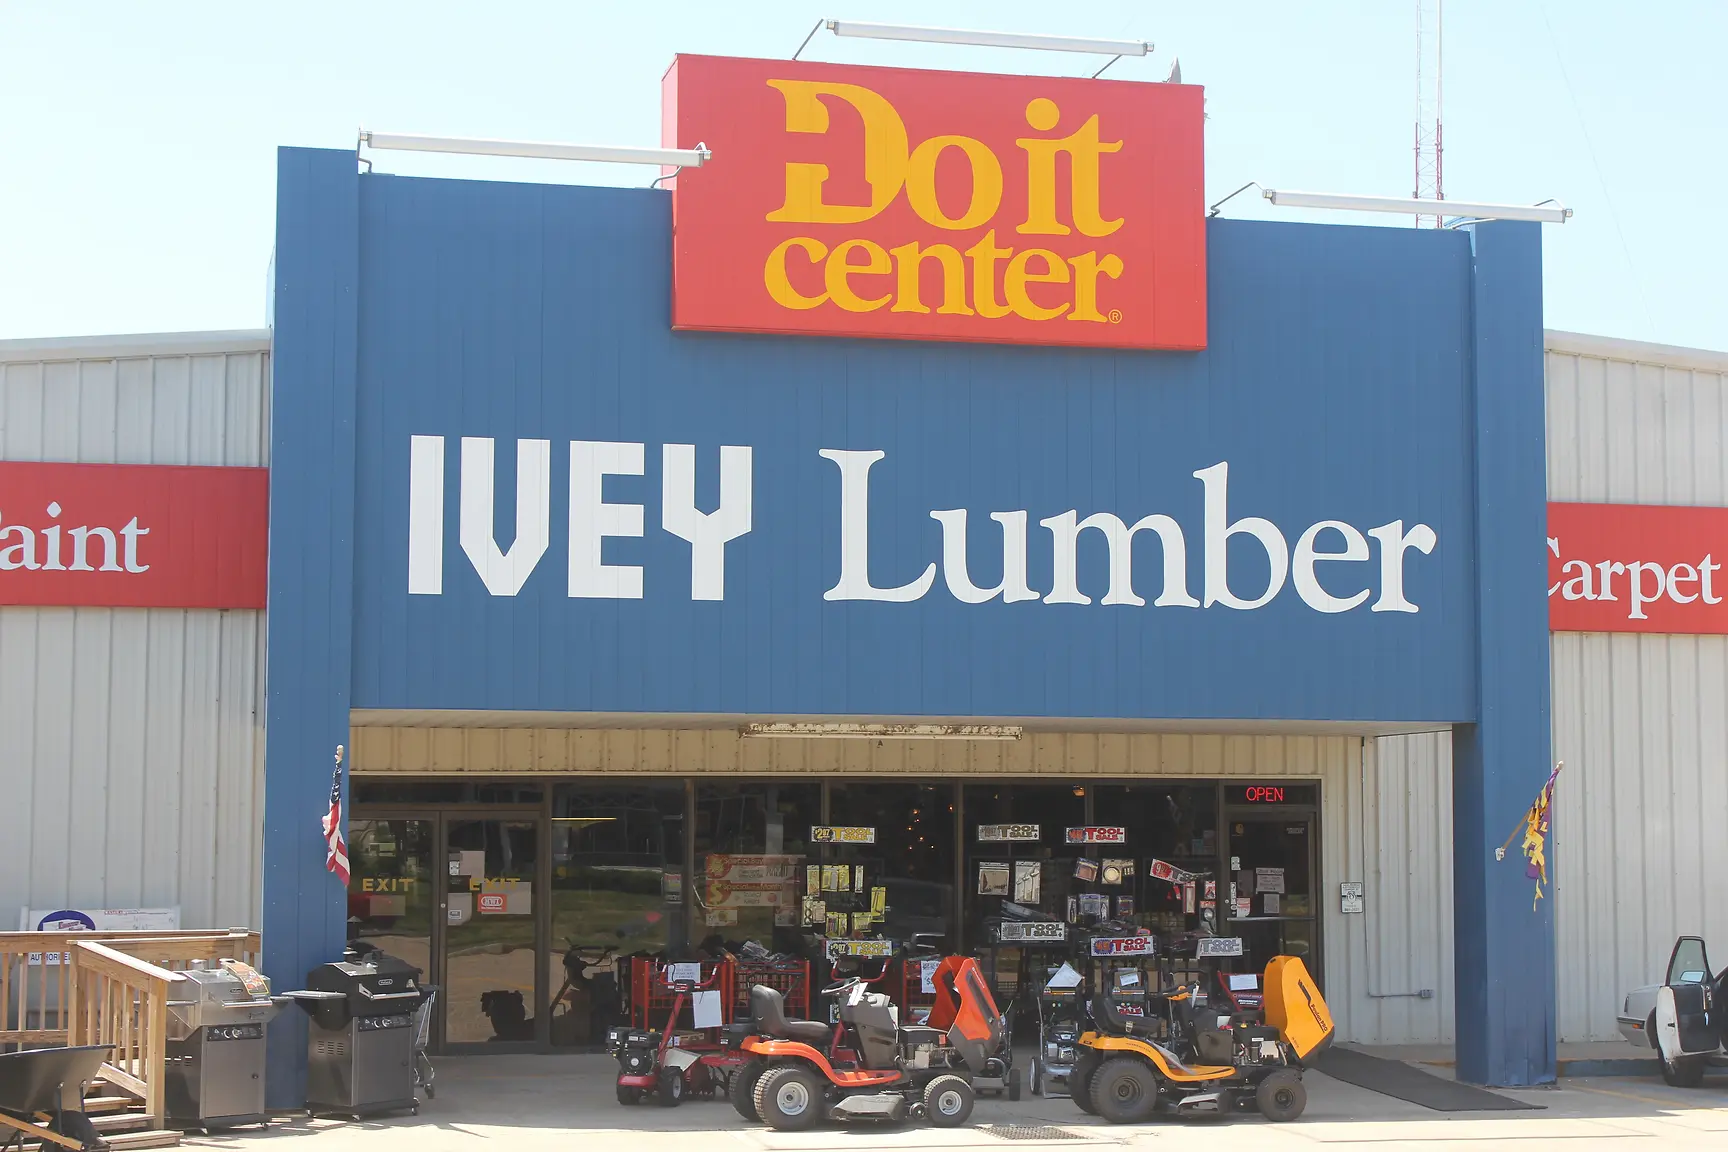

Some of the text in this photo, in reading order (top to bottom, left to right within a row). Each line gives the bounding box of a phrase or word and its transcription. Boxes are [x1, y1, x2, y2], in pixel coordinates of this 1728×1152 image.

[766, 78, 1124, 237] Do it
[764, 228, 1123, 323] center
[408, 434, 1437, 614] IVEY Lumber
[0, 501, 150, 574] aint
[1246, 786, 1284, 802] OPEN
[832, 827, 873, 841] TOOL
[997, 825, 1038, 838] TOOL
[1085, 827, 1124, 841] TOOL
[362, 878, 416, 893] EXIT
[469, 876, 521, 892] EXIT
[1021, 923, 1063, 937] TOOL
[847, 941, 890, 956] TOOL
[1111, 937, 1151, 952] TOOL
[1123, 943, 1146, 952] SALE
[1200, 939, 1240, 953] TOOL
